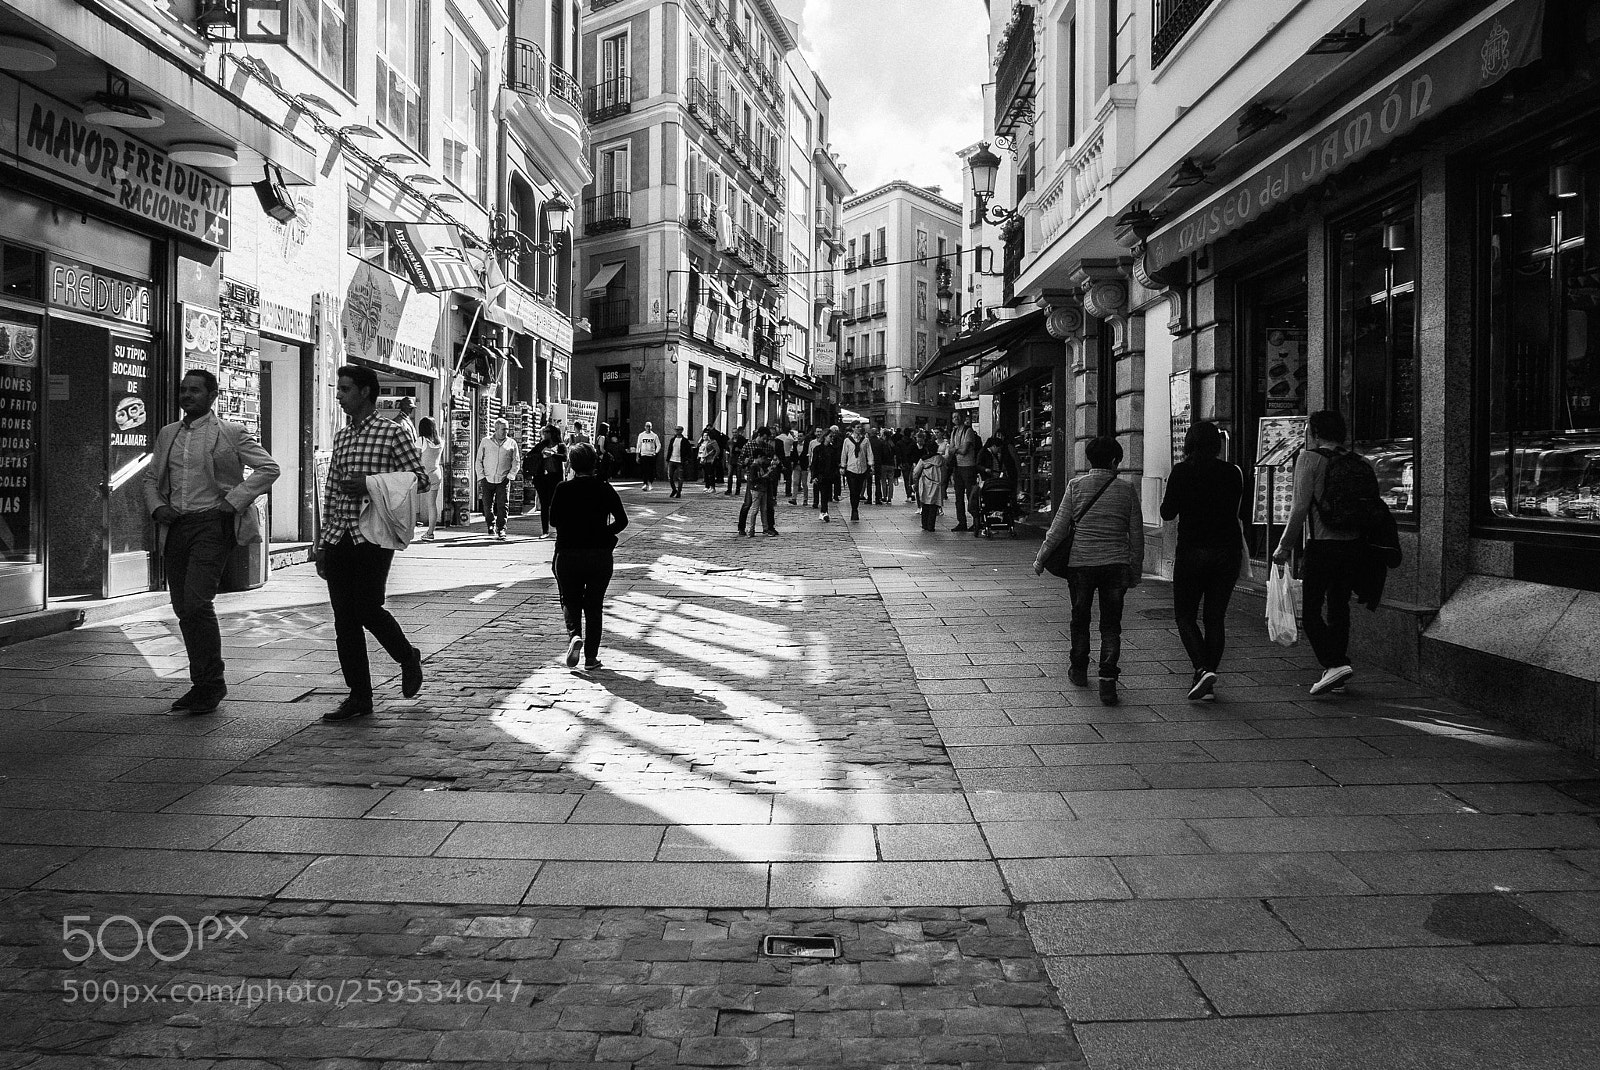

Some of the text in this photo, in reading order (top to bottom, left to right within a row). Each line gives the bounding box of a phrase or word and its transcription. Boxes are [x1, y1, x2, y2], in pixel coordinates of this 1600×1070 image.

[27, 102, 119, 185] MAYOR
[123, 140, 230, 217] FREIDURIA
[1178, 73, 1433, 252] MUSEO del JAMÓN
[119, 178, 199, 232] RACIONES
[53, 267, 150, 324] FREIDURIA
[114, 344, 125, 358] SU
[127, 380, 138, 393] DE
[602, 371, 619, 383] pans
[10, 398, 37, 412] FRITO
[2, 437, 30, 449] DIGAS
